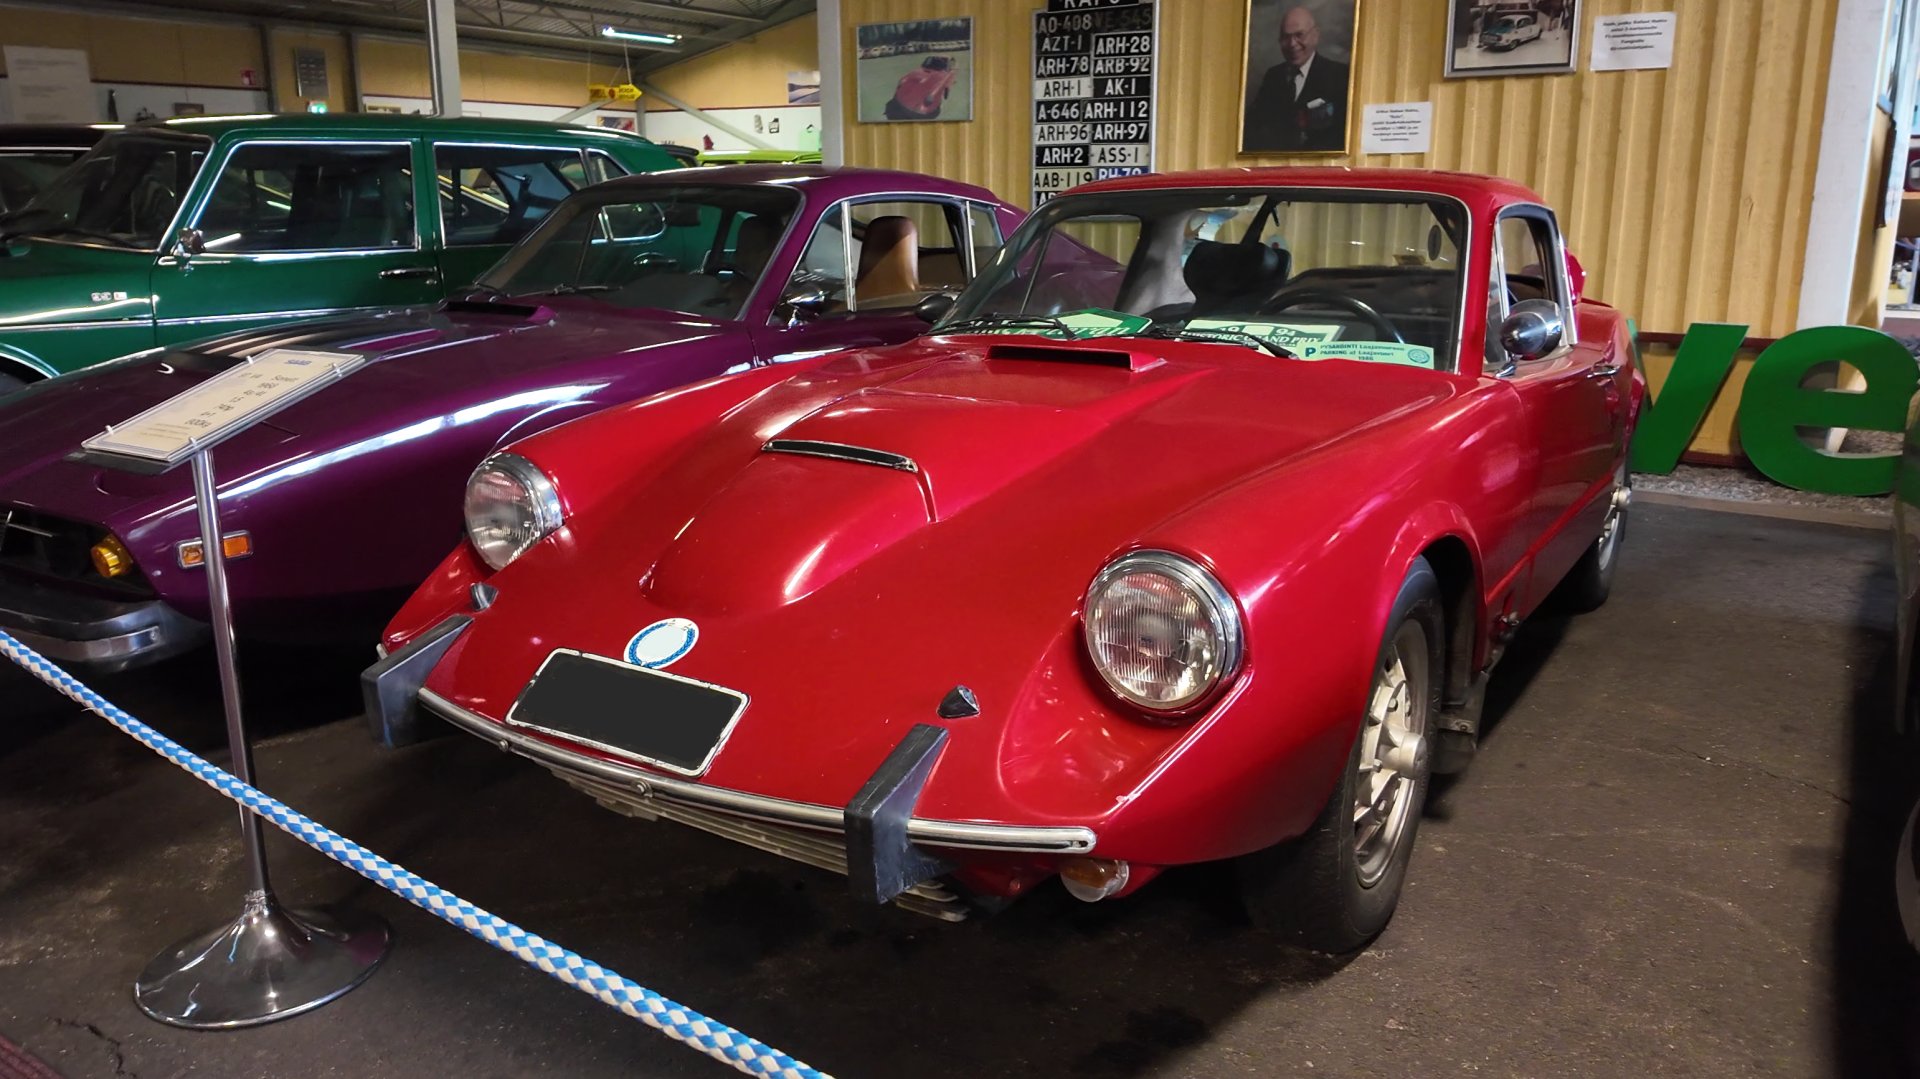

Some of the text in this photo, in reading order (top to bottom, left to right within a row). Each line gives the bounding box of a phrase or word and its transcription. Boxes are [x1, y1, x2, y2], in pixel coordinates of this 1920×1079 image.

[1041, 34, 1082, 53] AZT-1
[1095, 35, 1151, 55] ARH-28
[1037, 55, 1089, 78] ARH-78
[1094, 57, 1150, 74] ARB-92
[1043, 79, 1081, 98] ARH-1
[1104, 78, 1136, 96] AK-1
[1037, 102, 1080, 120] A-646
[1083, 100, 1148, 119] ARH-112
[1037, 124, 1088, 142] ARH-96
[1093, 123, 1148, 141] ARH-97
[1042, 147, 1084, 164] ARH-2
[1097, 147, 1138, 164] ASS-1
[1034, 171, 1093, 188] AAB-119
[1244, 334, 1290, 343] GAND
[1305, 347, 1317, 358] P
